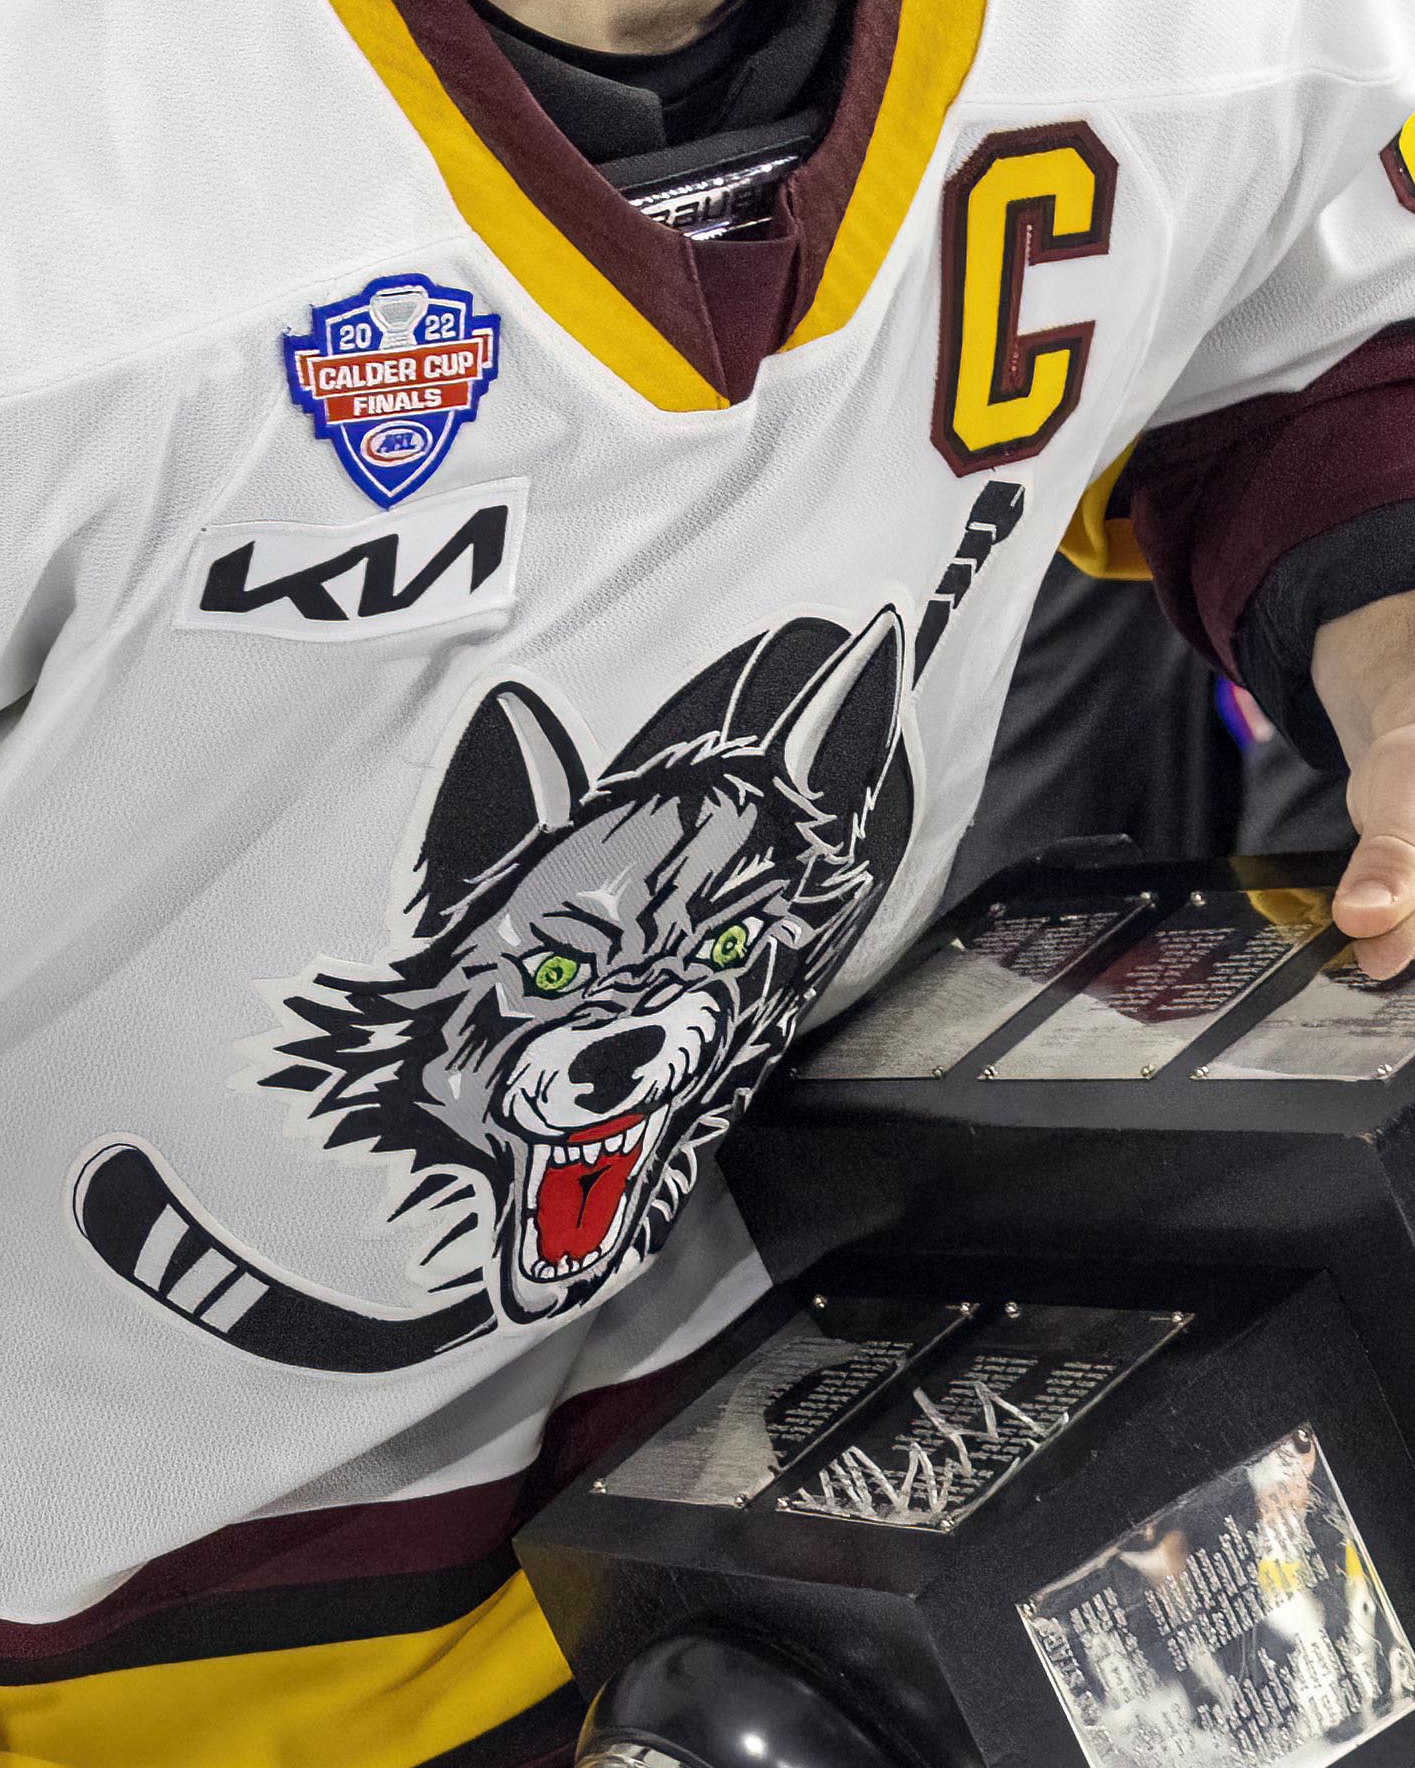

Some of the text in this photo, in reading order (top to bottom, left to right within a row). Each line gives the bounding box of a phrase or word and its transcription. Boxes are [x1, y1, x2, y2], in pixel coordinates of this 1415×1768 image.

[931, 121, 1119, 478] C
[339, 313, 457, 351] 20 22
[319, 350, 475, 390] CALDER CUP
[353, 387, 442, 416] FINALS
[200, 505, 508, 621] KIA
